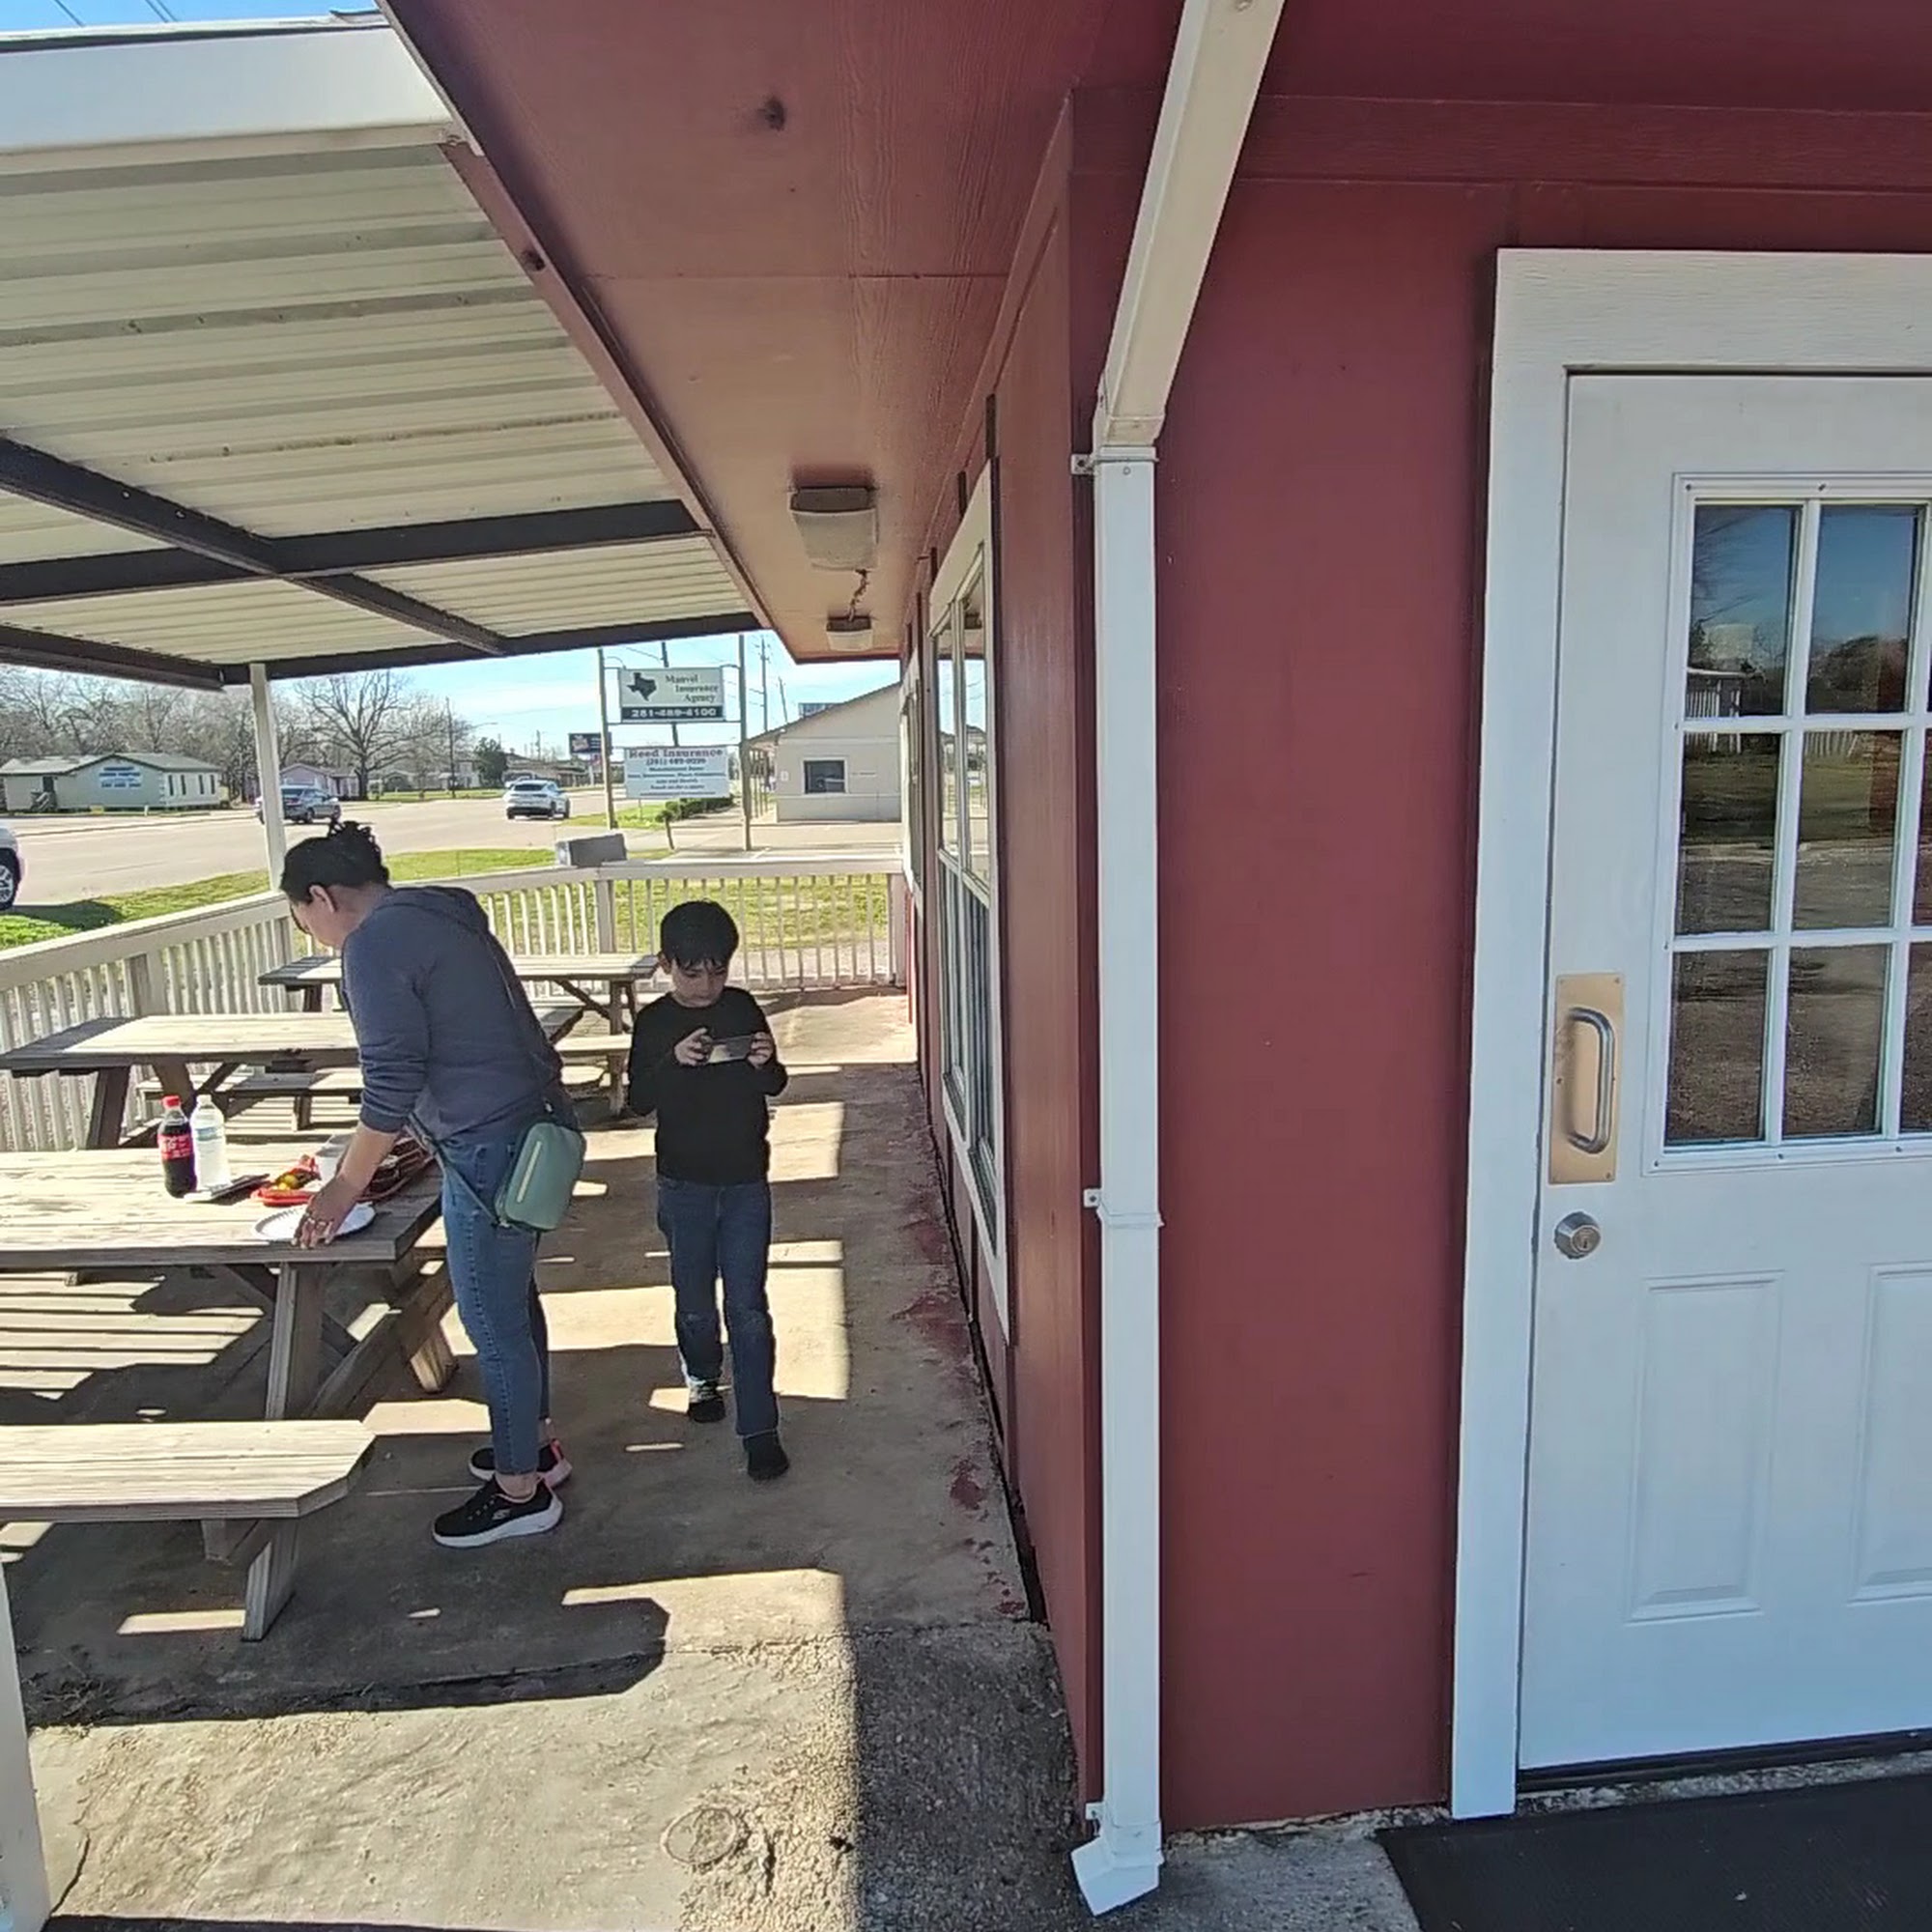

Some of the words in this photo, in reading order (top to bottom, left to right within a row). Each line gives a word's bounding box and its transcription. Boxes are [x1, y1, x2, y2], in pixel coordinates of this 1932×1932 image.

[684, 694, 715, 703] Agency
[629, 748, 659, 758] Reed
[663, 748, 723, 757] Insurance
